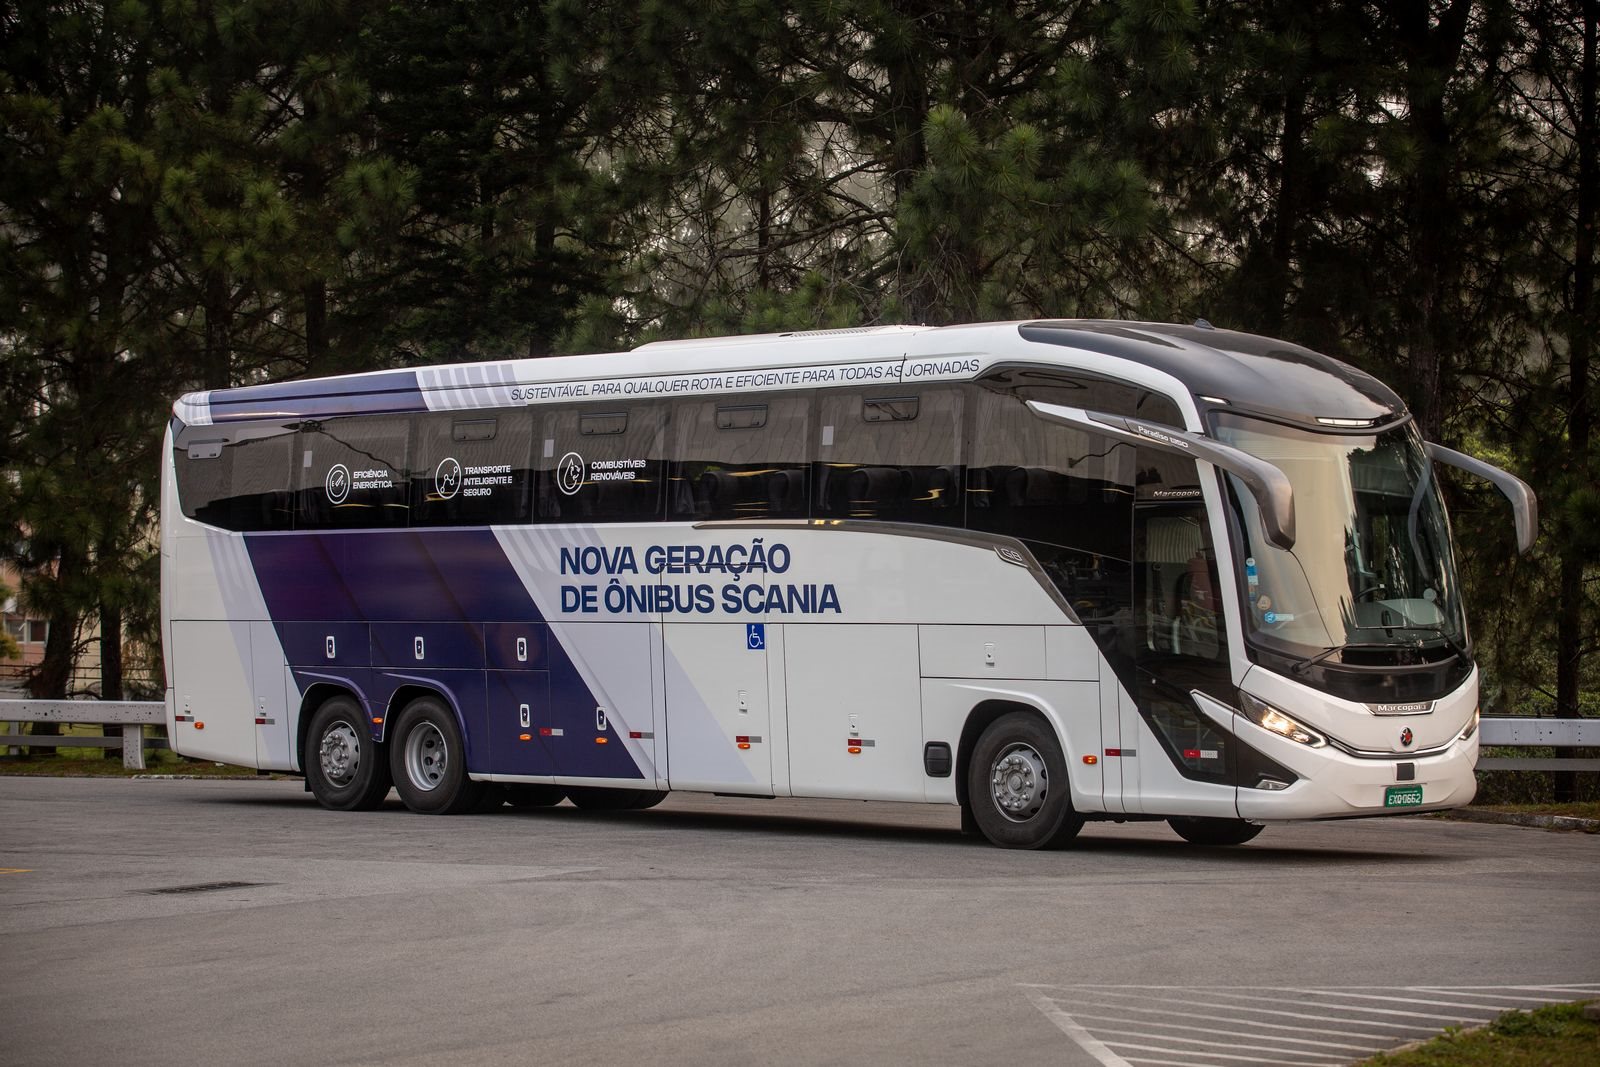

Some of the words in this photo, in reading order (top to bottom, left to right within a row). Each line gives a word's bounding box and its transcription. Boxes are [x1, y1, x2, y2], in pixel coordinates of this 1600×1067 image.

[511, 384, 589, 401] SUSTENTÁVEL
[591, 382, 622, 395] PARA
[624, 379, 689, 394] QUALQUER
[691, 376, 723, 390] ROTA
[725, 376, 734, 388] E
[735, 371, 800, 388] EFICIENTE
[802, 369, 835, 383] PARA
[839, 365, 882, 380] TODAS
[885, 365, 902, 378] AS
[905, 359, 980, 377] JORNADAS
[1138, 425, 1169, 441] Paradiso
[464, 465, 511, 475] TRANSPORTE
[591, 459, 646, 470] COMBUSTÍVEIS
[353, 468, 389, 479] EFICIÊNCIA
[590, 470, 636, 481] RENOVÁVEIS
[352, 480, 393, 490] ENERGÉTICA
[463, 476, 508, 486] INTELIGENTE
[508, 476, 513, 484] E
[463, 487, 492, 497] SEGURO
[1153, 490, 1200, 498] Marcopolo
[560, 546, 638, 575] NOVA
[645, 538, 791, 581] GERAÇÃO
[561, 585, 598, 613] DE
[604, 578, 715, 614] ÔNIBUS
[721, 584, 842, 614] SCANIA
[1377, 704, 1427, 712] Marcopolo
